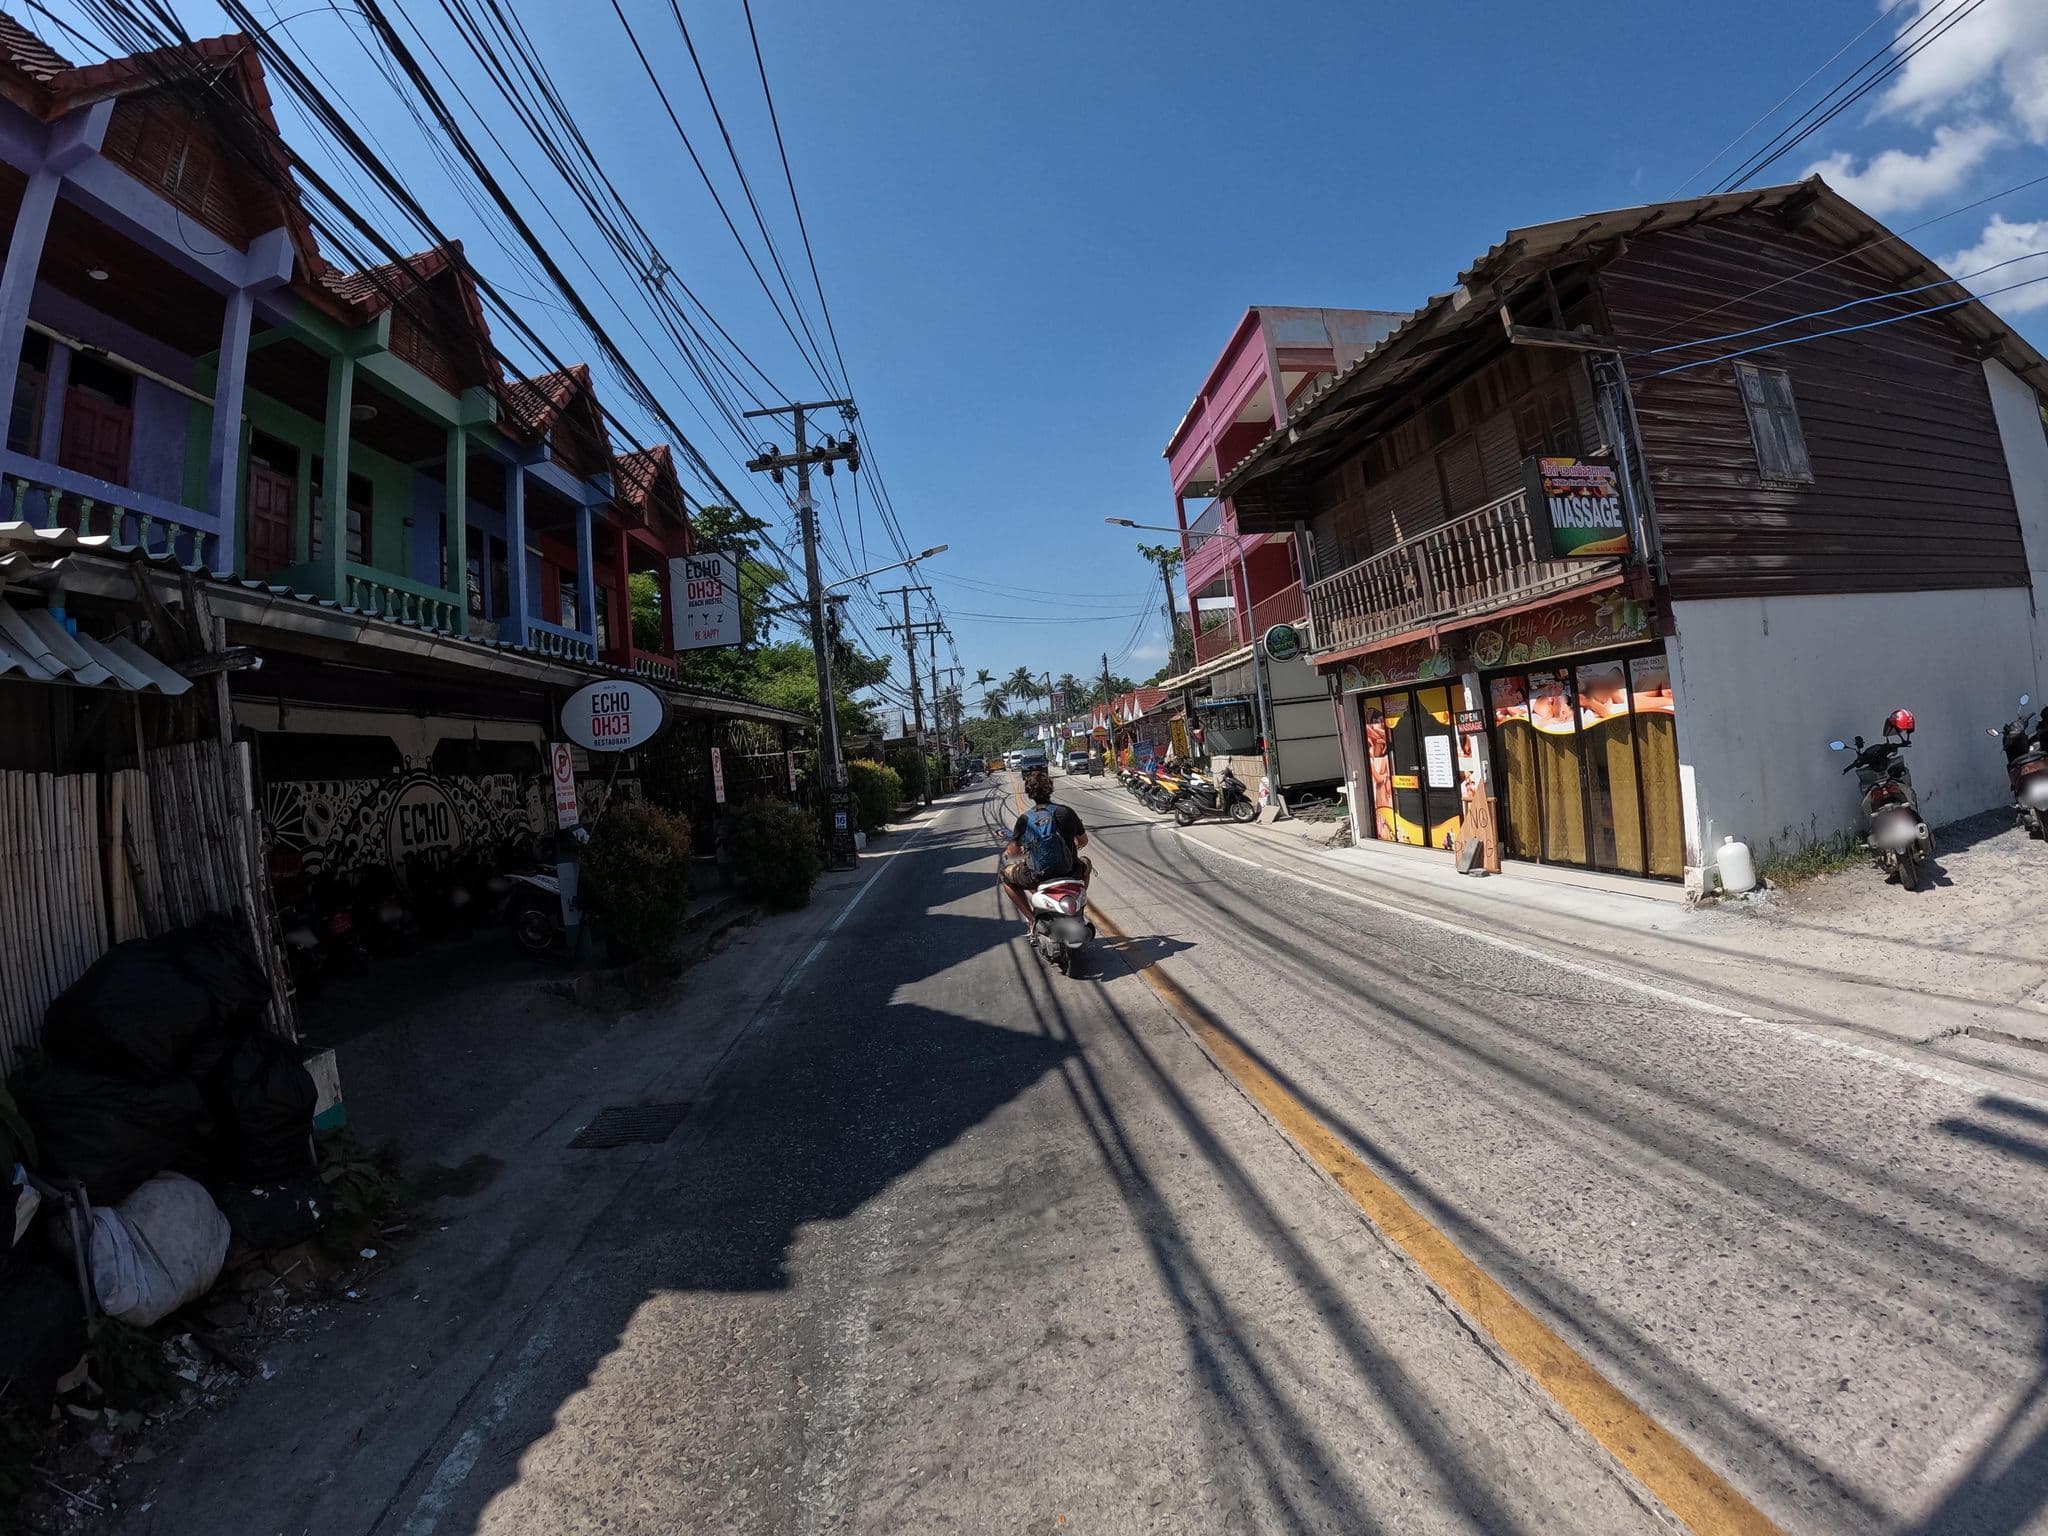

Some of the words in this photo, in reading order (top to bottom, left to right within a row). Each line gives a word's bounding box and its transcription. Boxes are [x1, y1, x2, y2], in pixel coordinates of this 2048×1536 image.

[1549, 497, 1623, 528] MASSAGE
[686, 559, 720, 579] ECHO
[688, 600, 705, 608] BEACH
[705, 597, 723, 606] HOSTEL
[592, 691, 630, 714] ECHO
[1458, 721, 1483, 732] MASSAGE
[1459, 712, 1478, 723] OPEN
[594, 737, 631, 747] RESTAURANT
[400, 801, 449, 846] ECHO
[1469, 807, 1488, 829] NO
